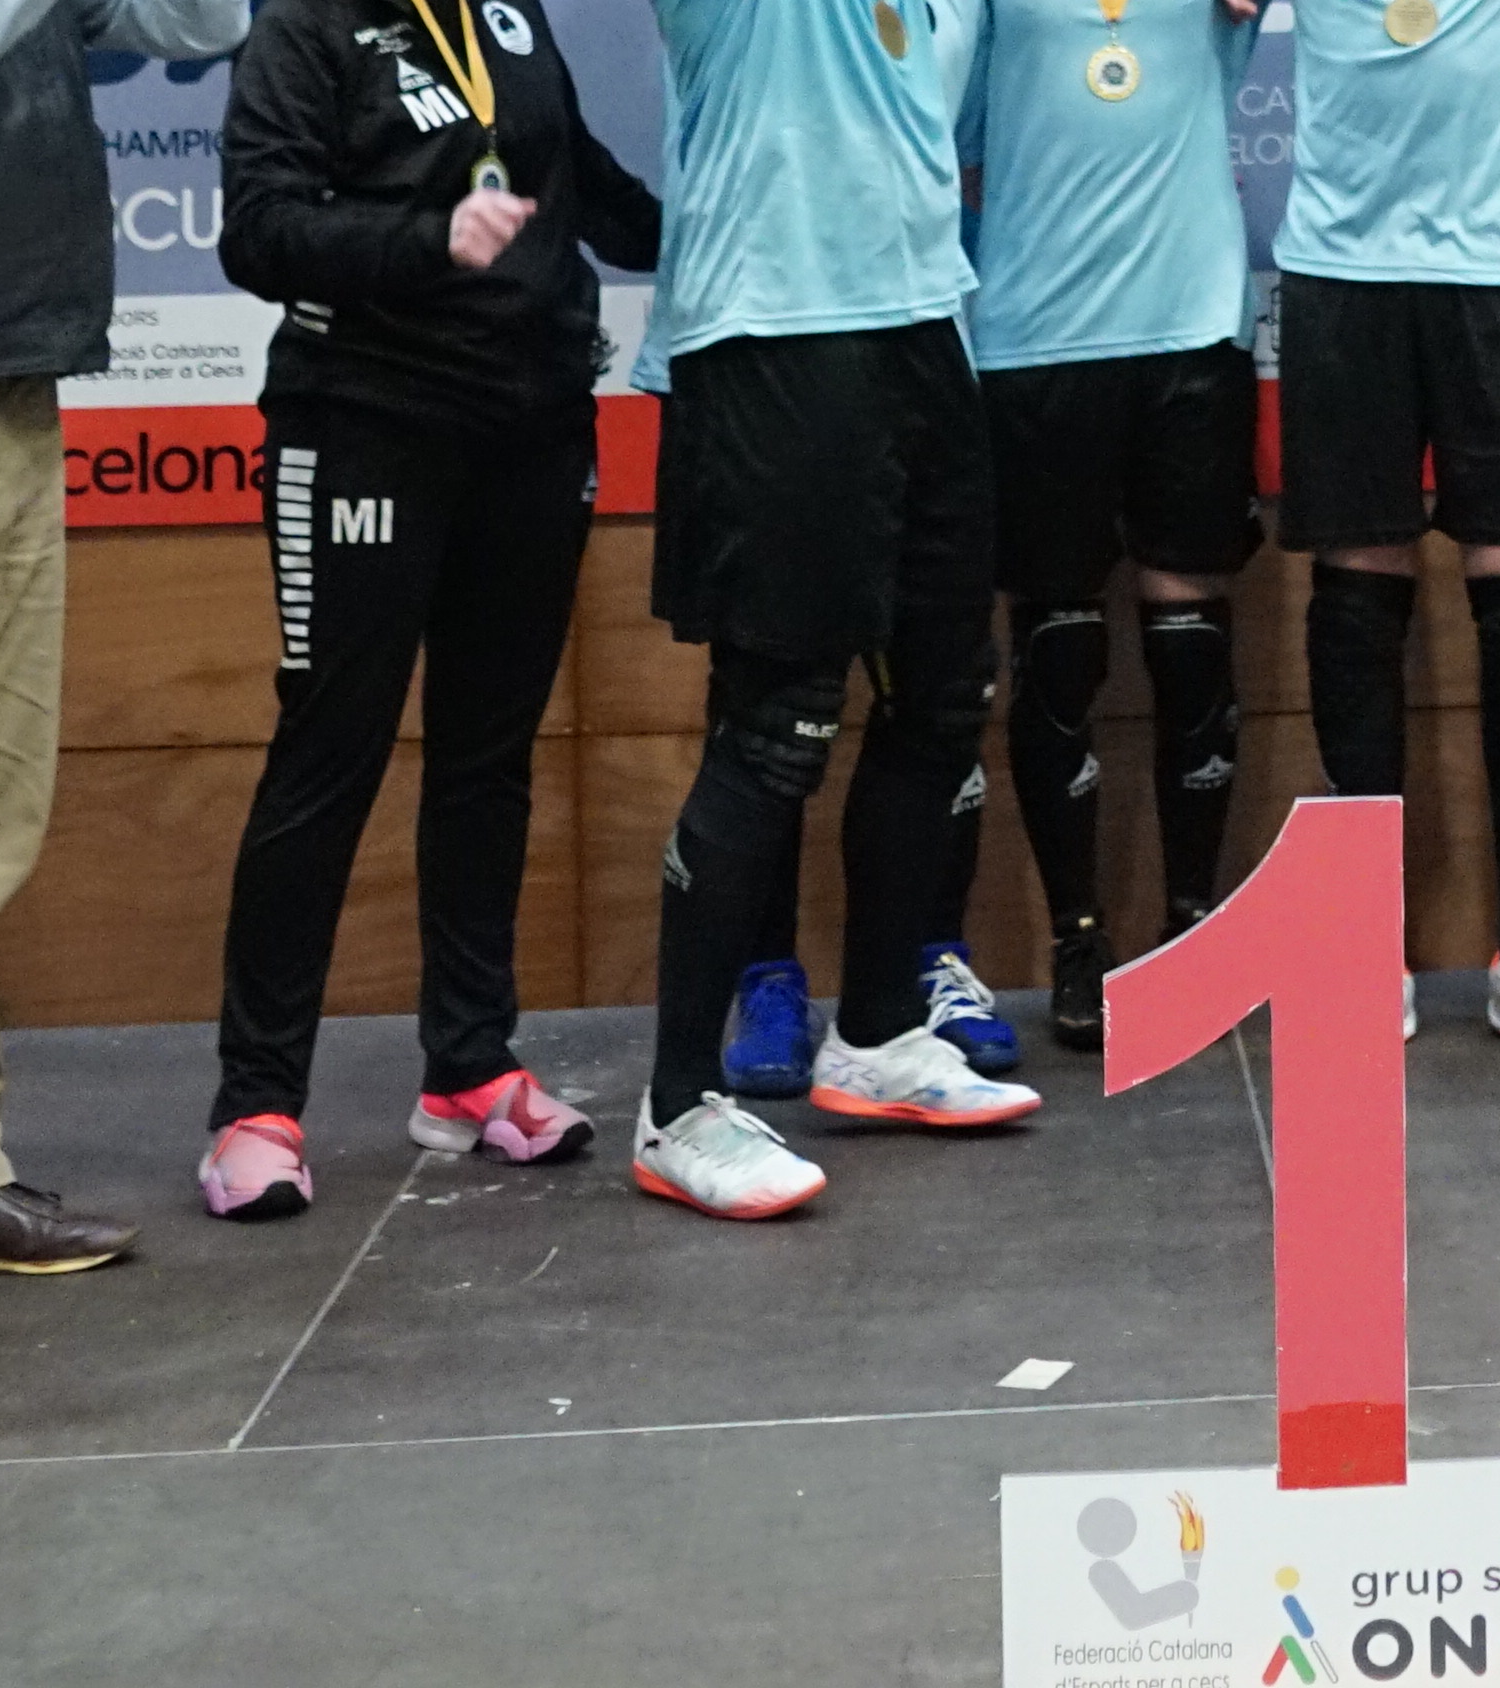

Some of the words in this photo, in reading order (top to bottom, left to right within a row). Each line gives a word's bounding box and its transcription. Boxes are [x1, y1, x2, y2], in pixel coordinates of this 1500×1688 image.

[400, 84, 470, 133] MI
[151, 343, 241, 360] Catalana
[331, 498, 394, 544] MI
[1352, 1568, 1464, 1608] grup
[1054, 1638, 1144, 1666] Federació
[1149, 1638, 1233, 1661] Catalana
